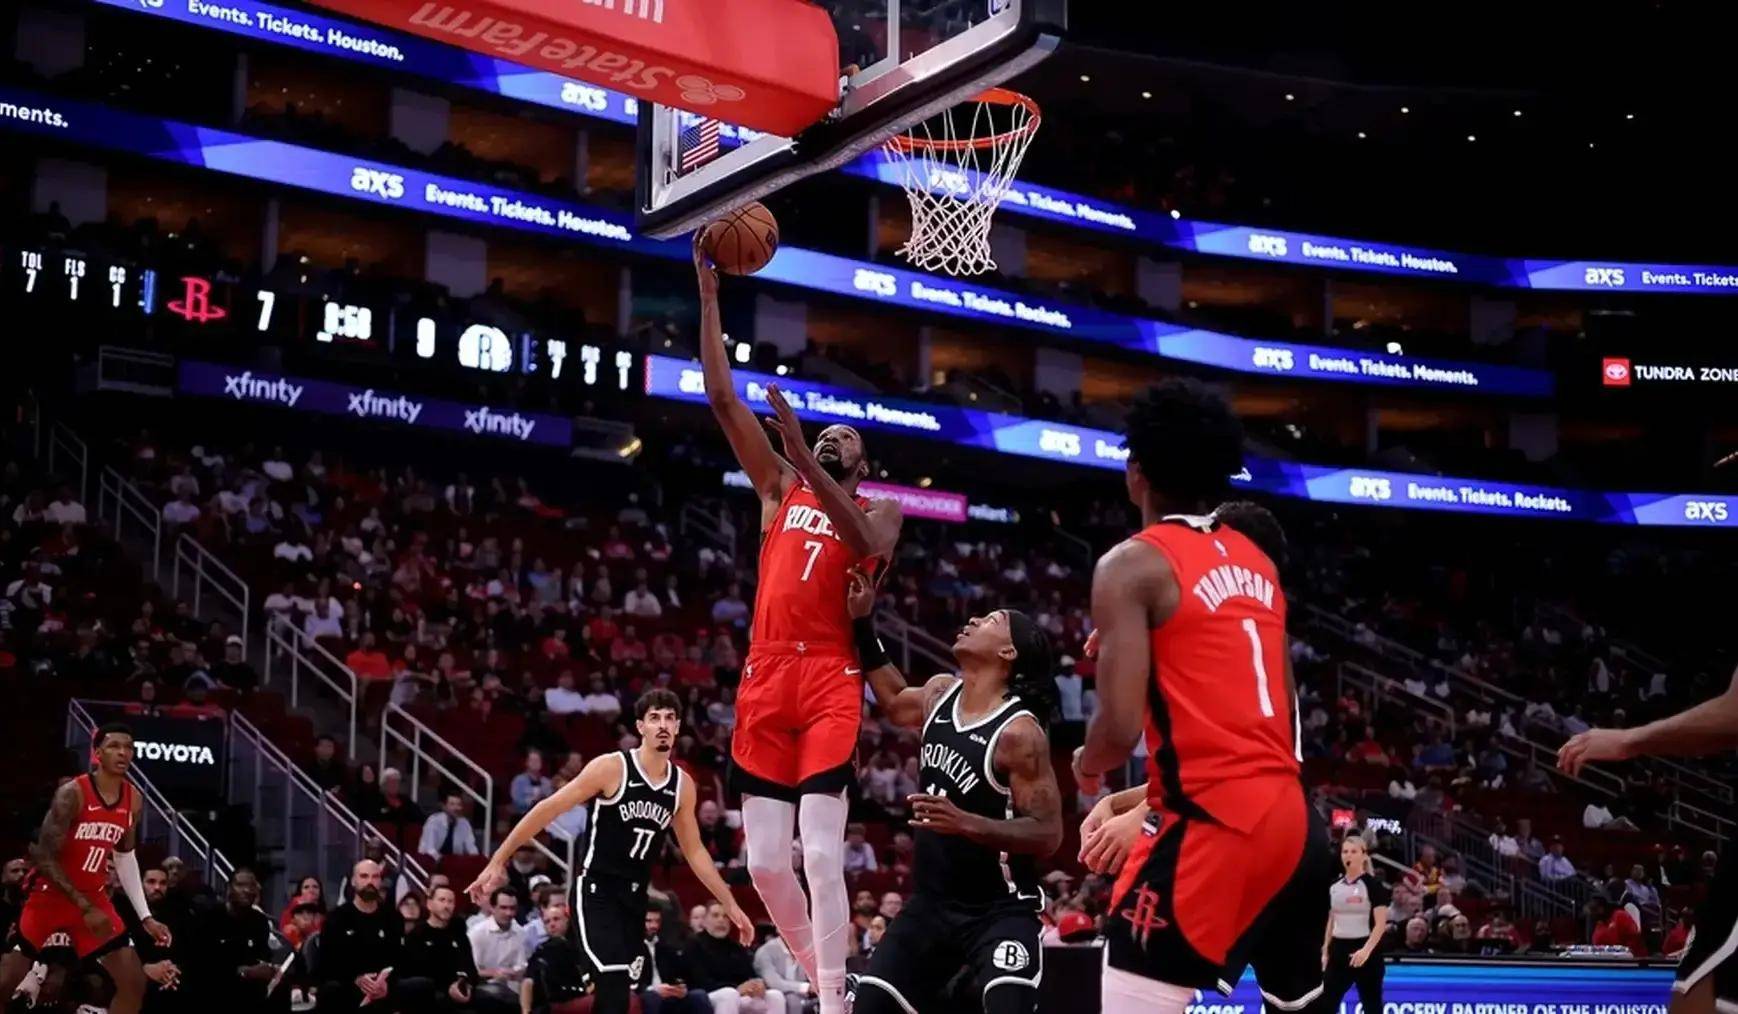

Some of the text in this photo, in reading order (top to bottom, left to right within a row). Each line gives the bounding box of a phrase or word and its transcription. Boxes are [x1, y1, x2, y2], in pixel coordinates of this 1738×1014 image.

[187, 0, 404, 61] Events. Tickets. Houston.
[350, 166, 632, 241] axs Events. Tickets. Houston.
[21, 251, 42, 270] TOL
[65, 258, 86, 277] FLS
[1249, 234, 1458, 273] axs Events. Tickets. Houston.
[26, 270, 36, 293] 7
[69, 277, 78, 300] 1
[1585, 267, 1625, 287] axs
[1642, 271, 1691, 285] Events.
[112, 283, 121, 307] 1
[257, 290, 275, 331] 7
[1253, 347, 1479, 386] axs Events. Tickets. Moments.
[1634, 365, 1695, 381] TUNDRA
[224, 371, 303, 407] xfinity
[348, 390, 423, 423] xfinity
[464, 408, 535, 441] xfinity
[1349, 476, 1572, 512] axs Events. Tickets. Rockets.
[1684, 501, 1728, 523] axs
[801, 540, 824, 581] 7
[1193, 564, 1274, 613] THOMPSON
[1241, 618, 1275, 717] 1
[133, 741, 215, 765] TOYOTA
[619, 800, 673, 831] BROOKLYN
[74, 821, 125, 845] ROCKETS
[629, 827, 656, 860] 77
[82, 846, 105, 872] 10
